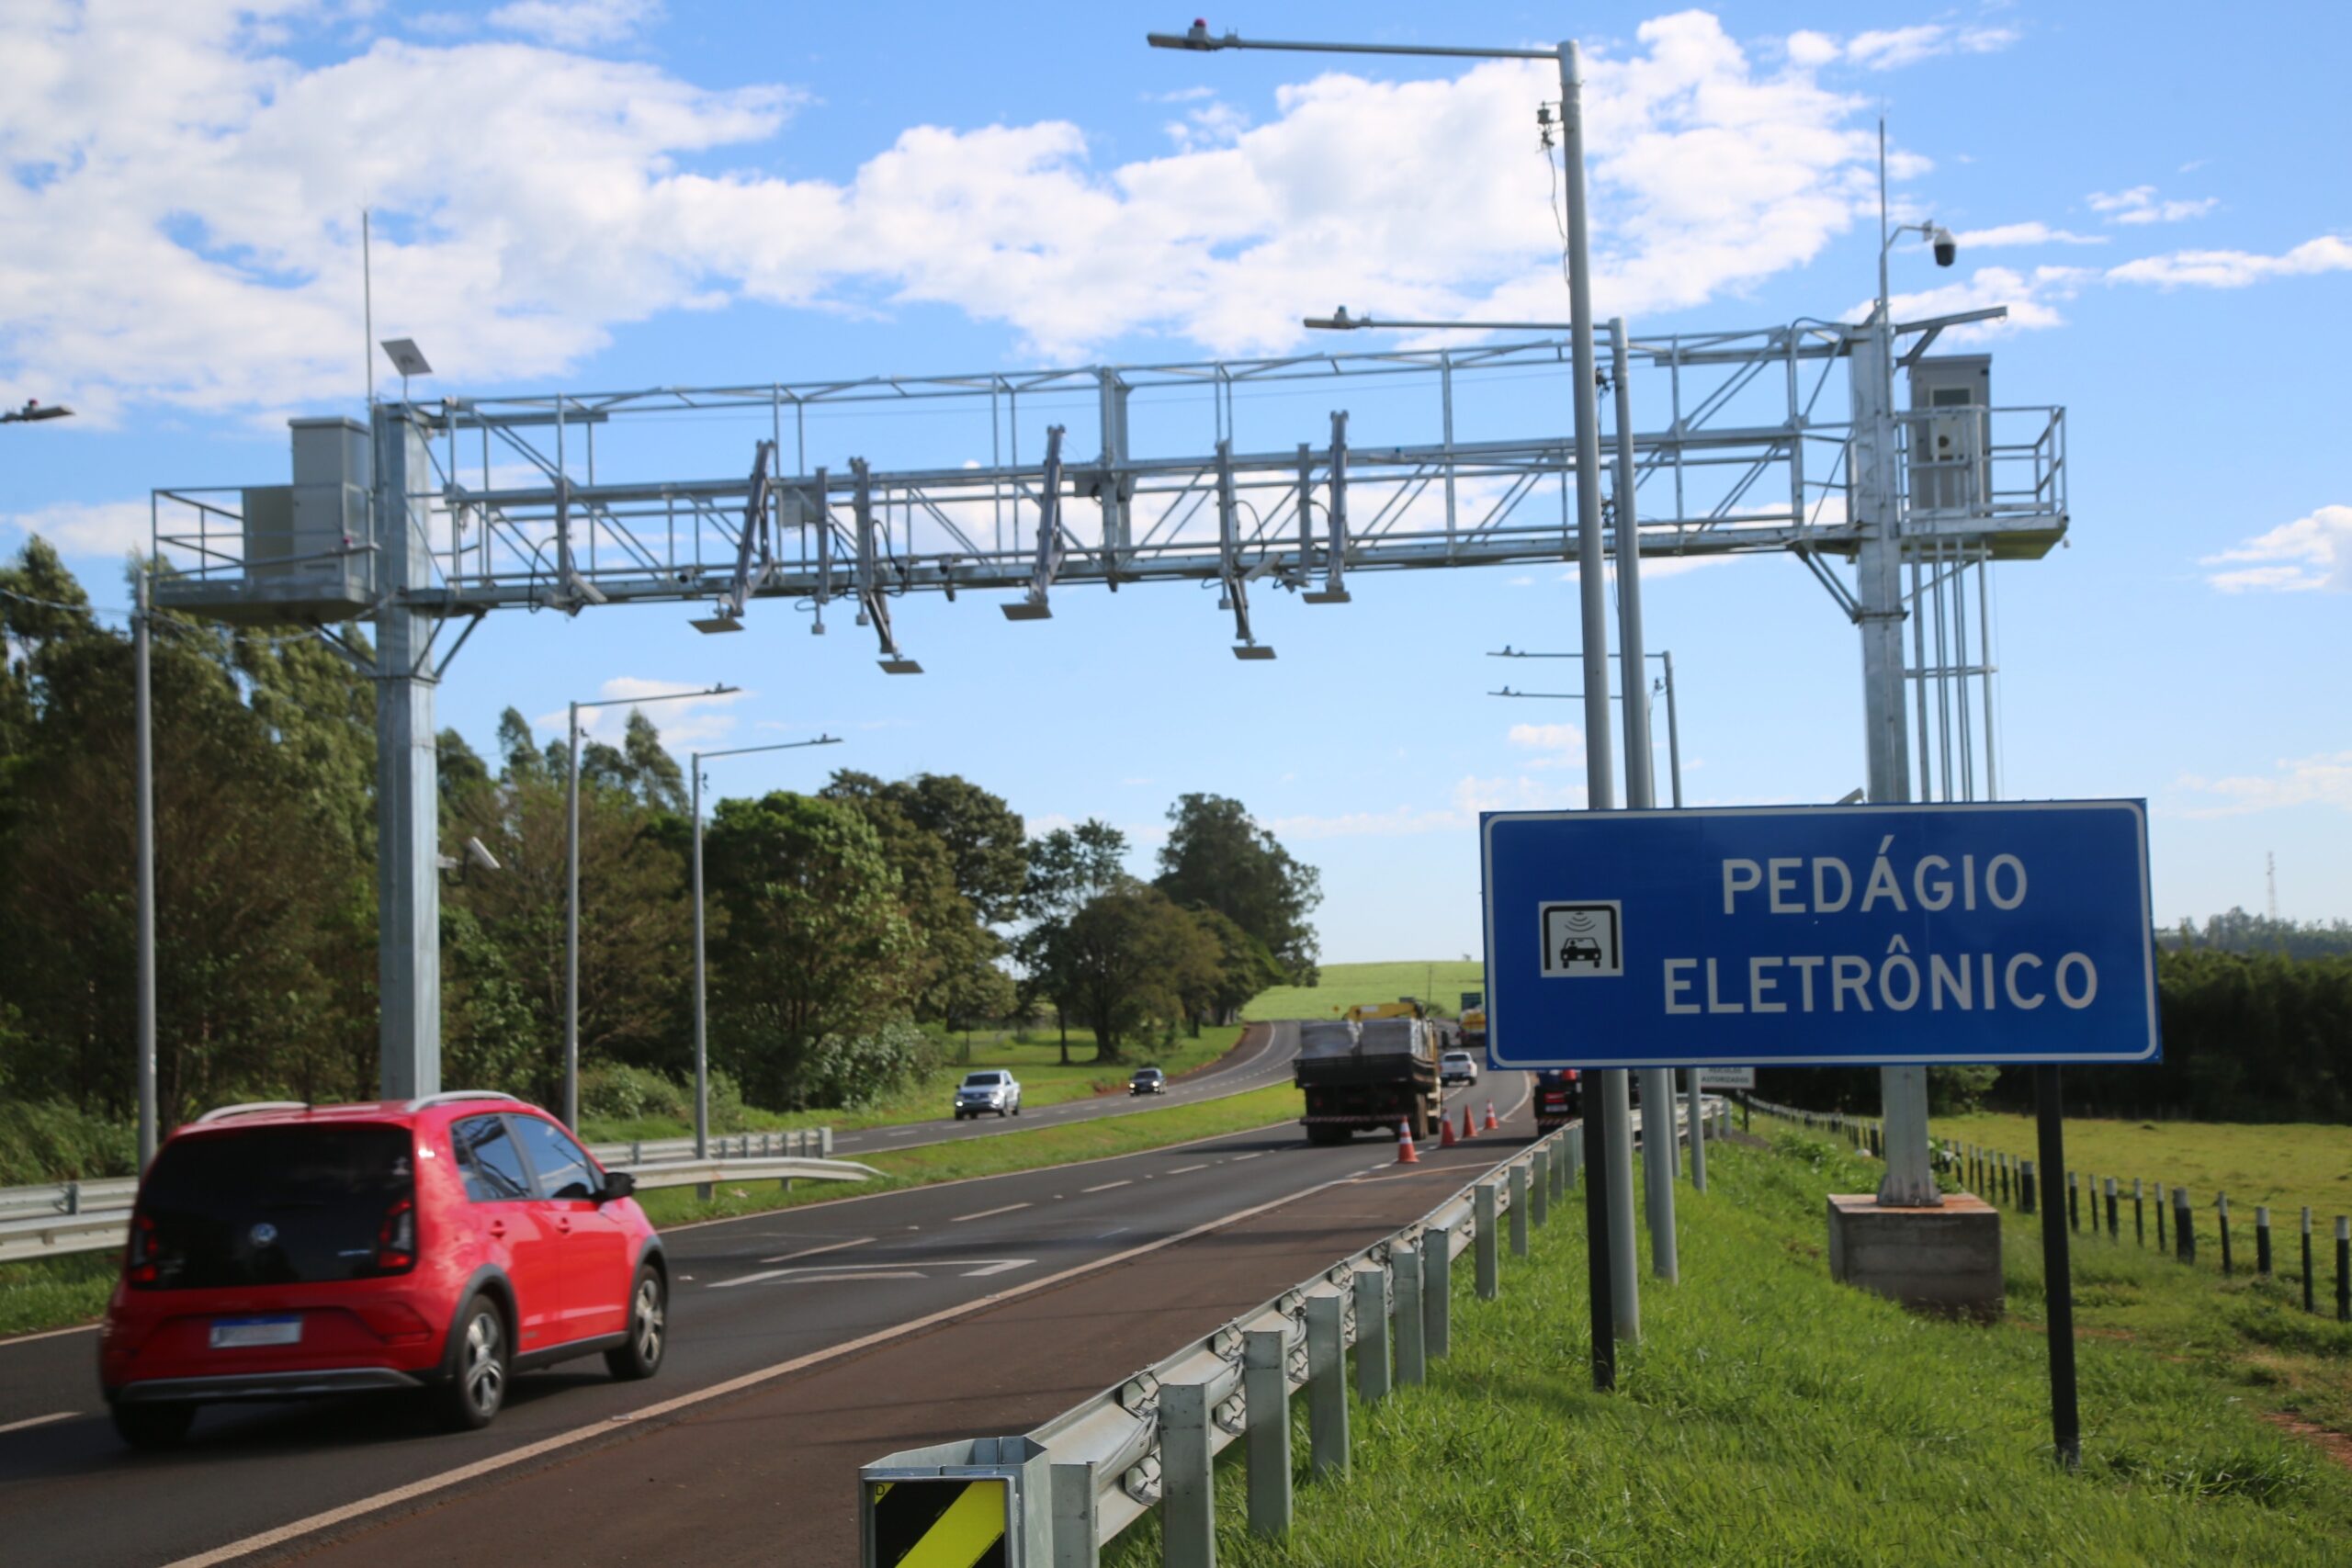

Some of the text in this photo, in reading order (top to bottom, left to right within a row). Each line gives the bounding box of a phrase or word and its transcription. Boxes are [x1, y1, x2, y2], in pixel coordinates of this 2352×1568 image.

[1722, 835, 2028, 915] PEDÁGIO
[1663, 934, 2098, 1015] ELETRÔNICO
[876, 1483, 886, 1496] D
